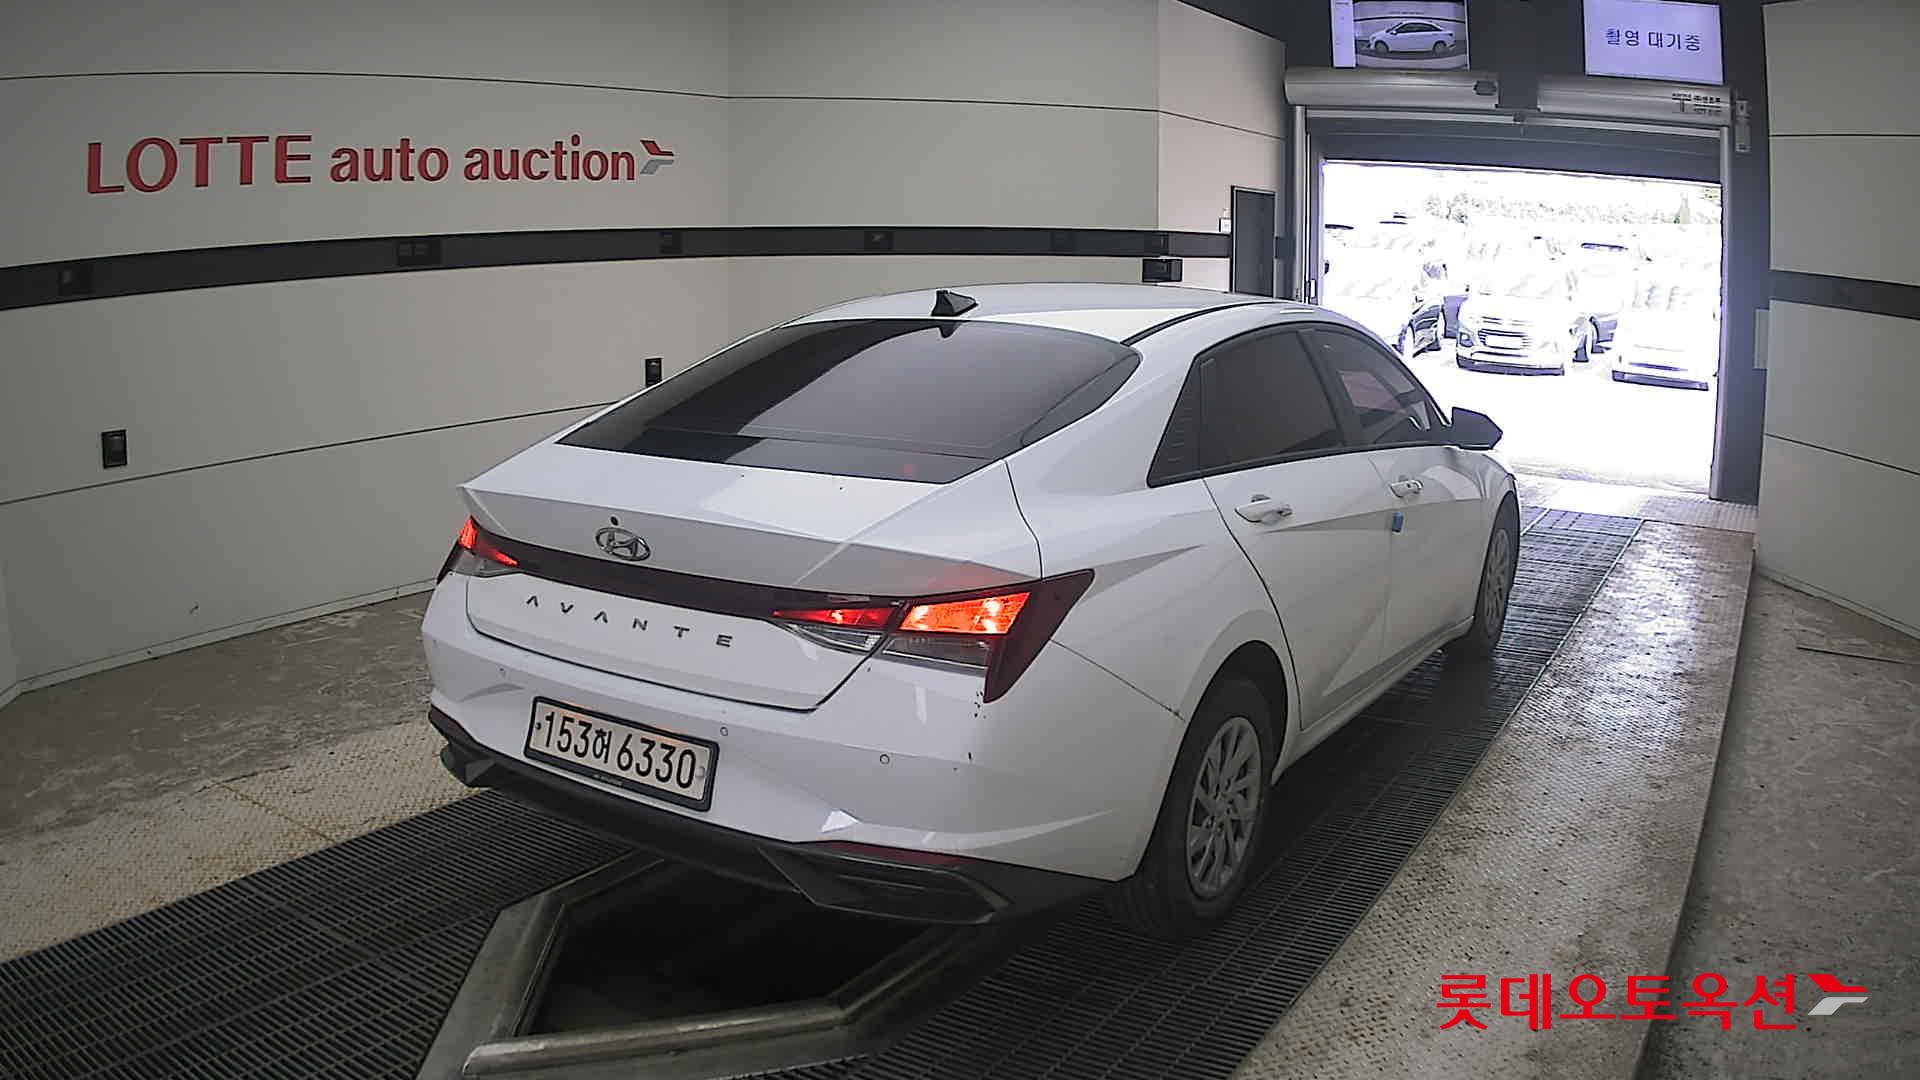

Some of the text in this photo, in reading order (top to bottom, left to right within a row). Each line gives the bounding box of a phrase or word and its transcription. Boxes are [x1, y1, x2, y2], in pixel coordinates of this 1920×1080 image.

[87, 134, 636, 194] LOTTE auto auction
[526, 595, 733, 648] AVANTE
